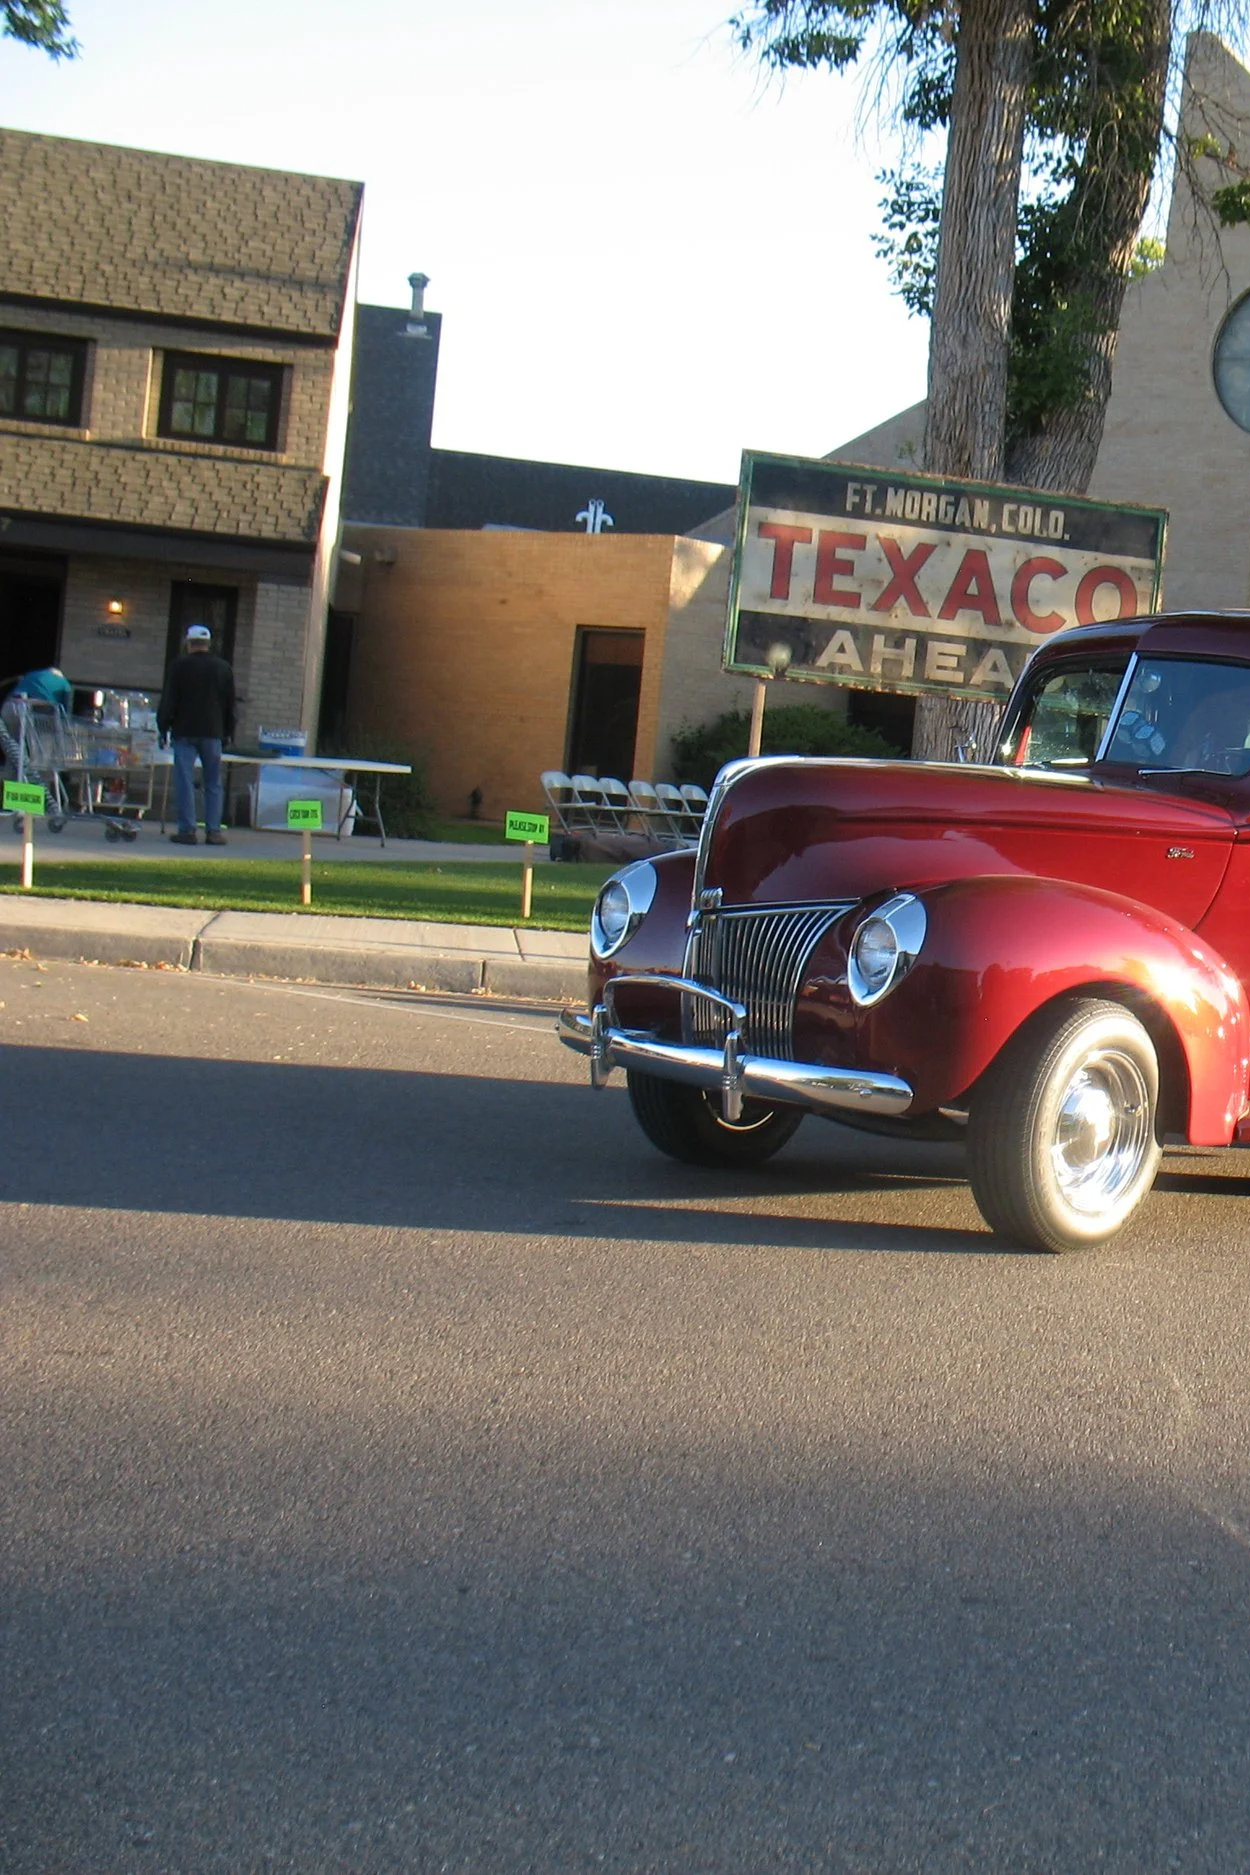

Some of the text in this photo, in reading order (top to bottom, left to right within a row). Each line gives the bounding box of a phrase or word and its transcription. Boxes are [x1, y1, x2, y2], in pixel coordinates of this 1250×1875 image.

[845, 481, 1071, 541] FT. MORGAN, COLO.
[757, 522, 1138, 634] TEXACO
[815, 629, 1032, 692] AHEA
